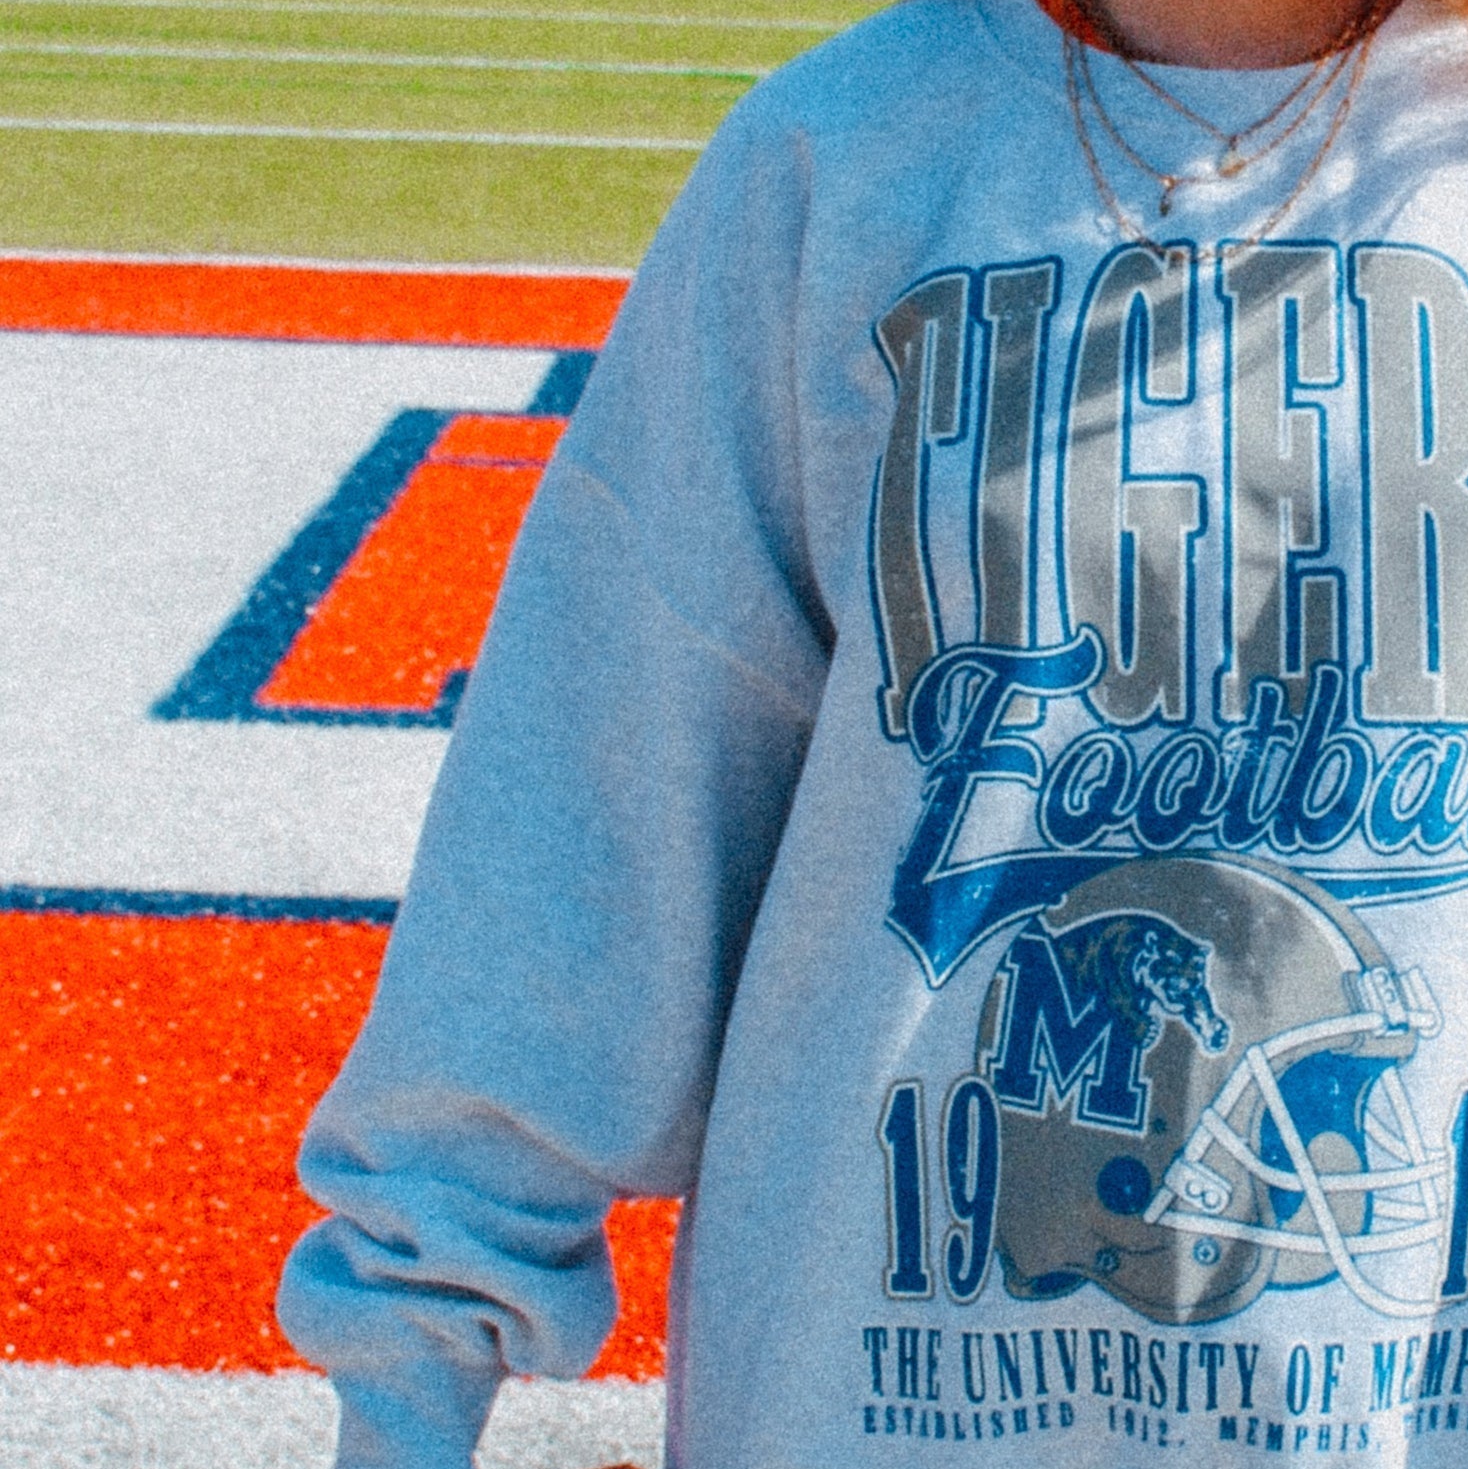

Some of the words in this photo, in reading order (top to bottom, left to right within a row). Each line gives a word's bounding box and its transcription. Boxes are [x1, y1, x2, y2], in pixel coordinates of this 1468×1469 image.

[984, 930, 1150, 1139] M
[879, 1075, 1000, 1303] 19
[863, 1327, 941, 1401] THE
[961, 1327, 1259, 1414] UNIVERSITY
[1286, 1343, 1344, 1416] OF
[864, 1401, 1075, 1440] ESTABLISHED
